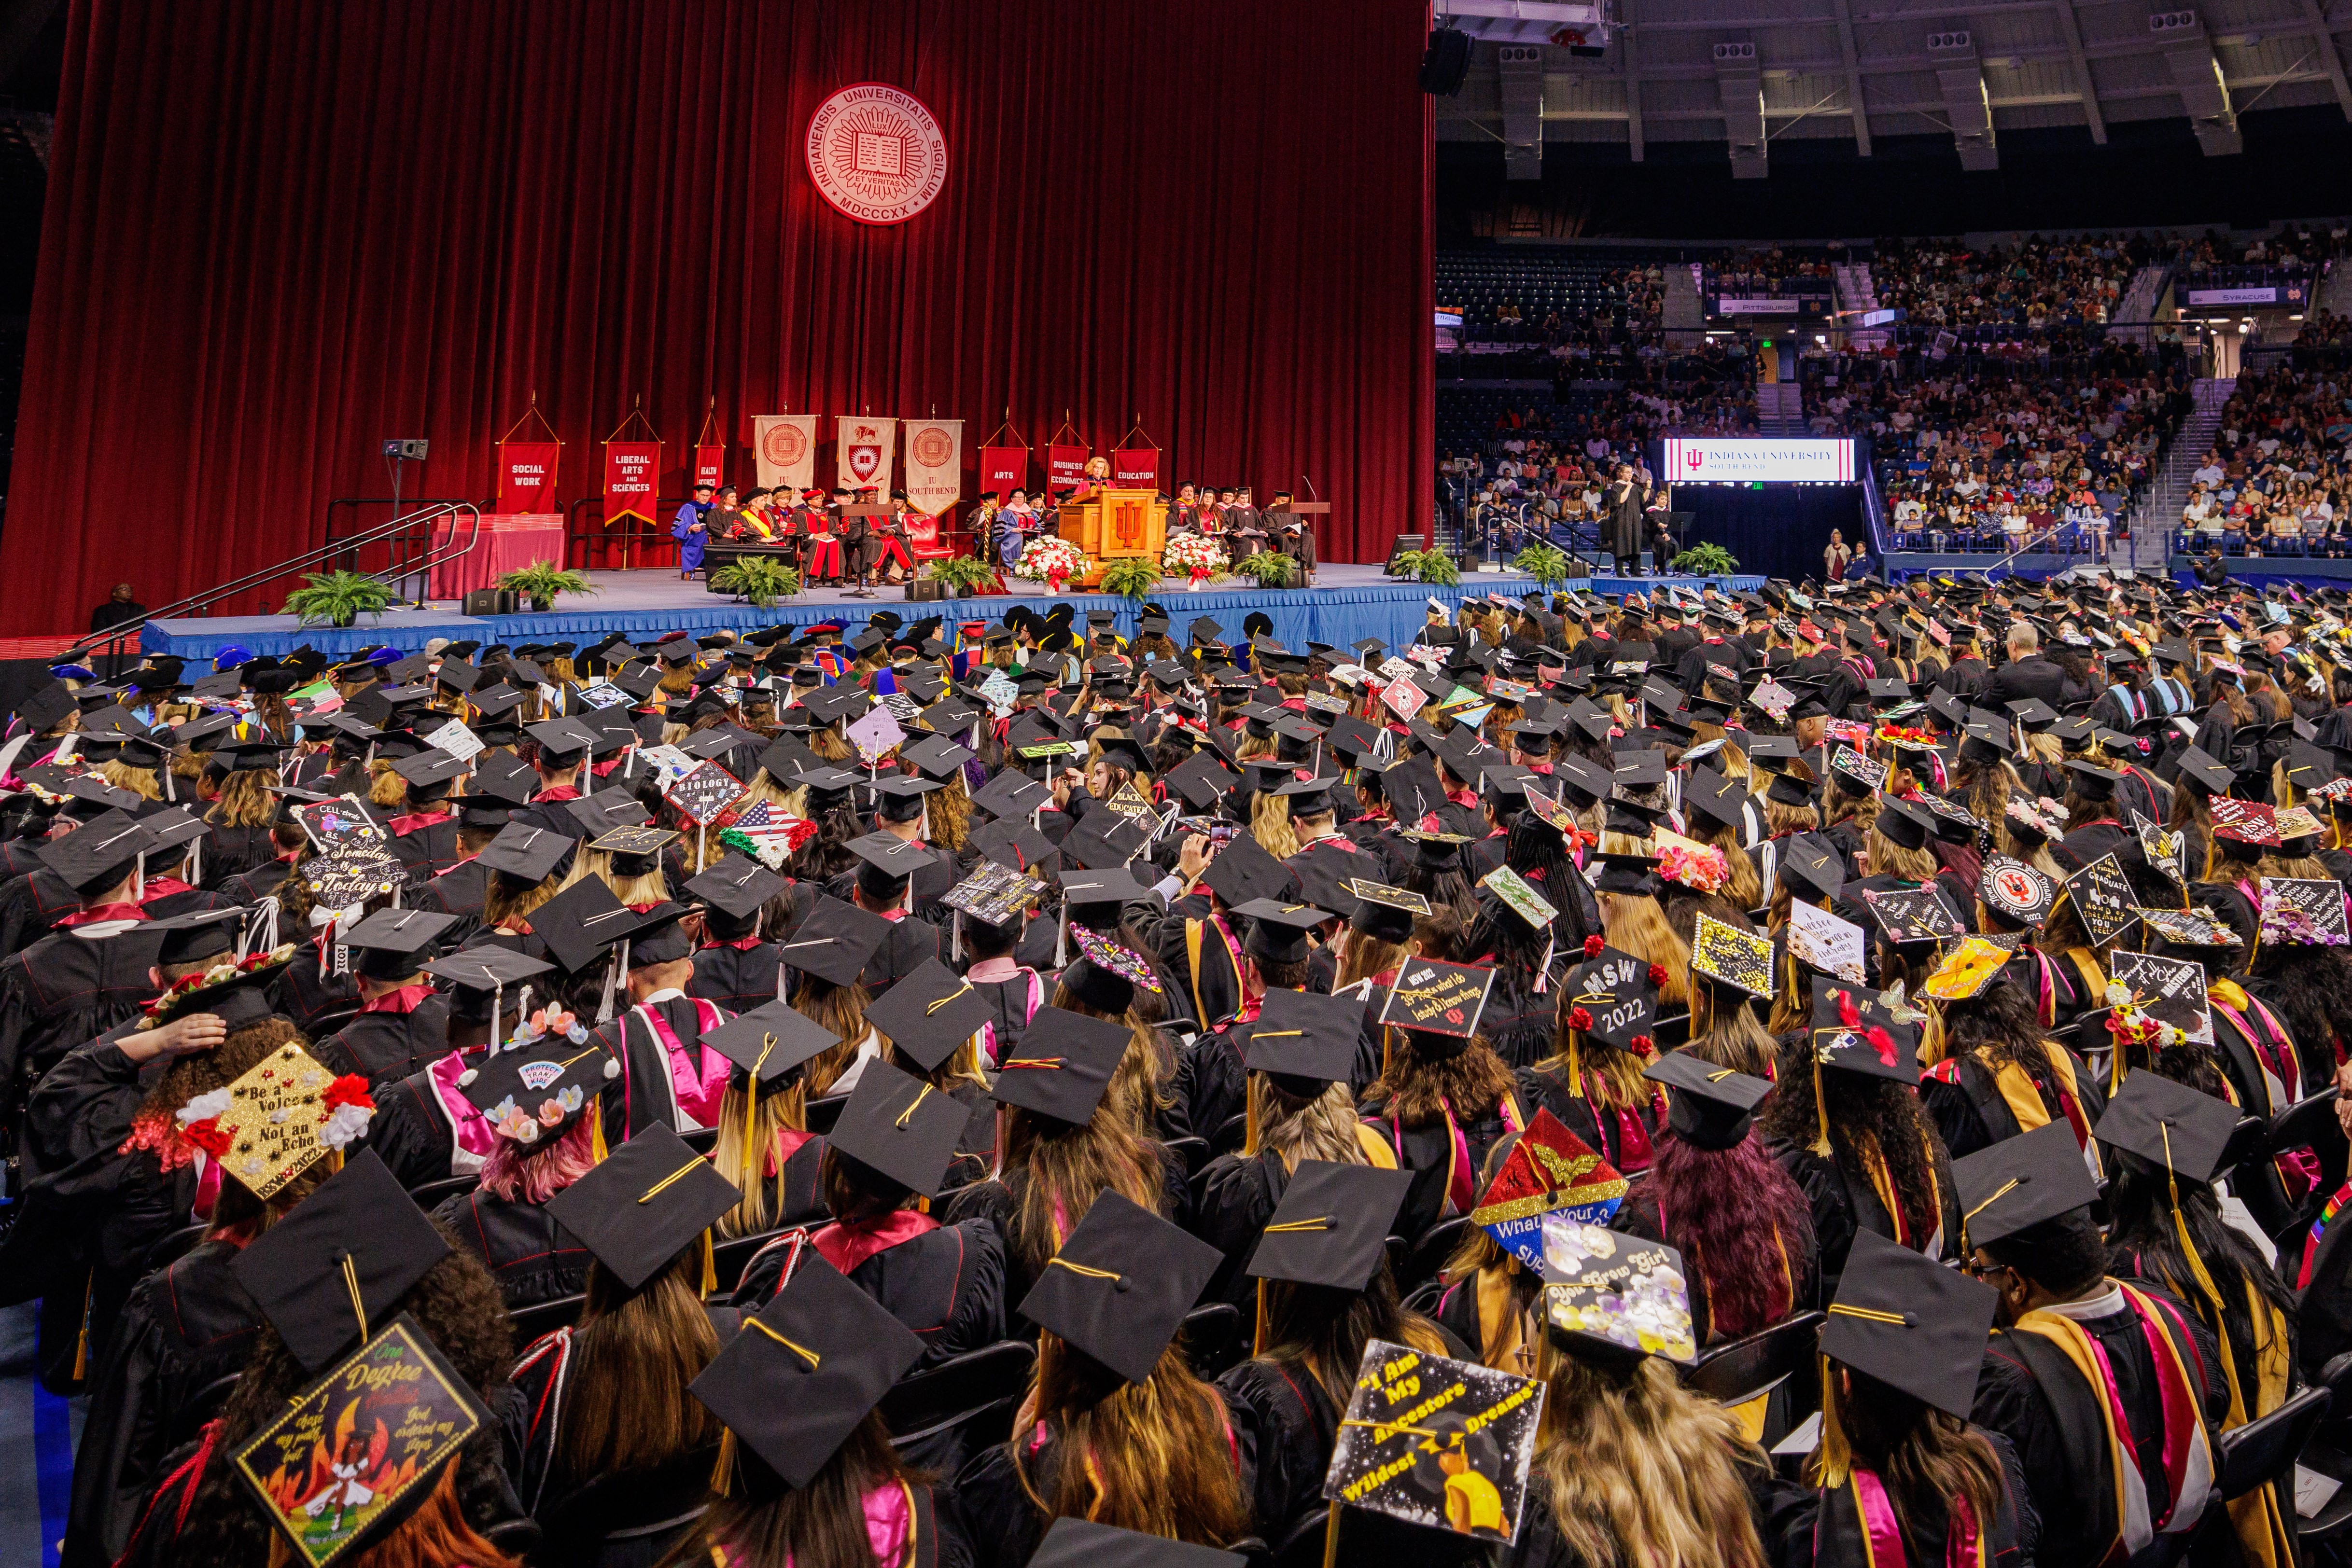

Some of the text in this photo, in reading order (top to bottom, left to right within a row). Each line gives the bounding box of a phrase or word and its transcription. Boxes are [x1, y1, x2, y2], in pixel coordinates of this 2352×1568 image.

[873, 123, 887, 131] LUX
[811, 88, 944, 201] INDIANENSIS UNIVERSITATIS SIGILLUM
[868, 177, 901, 188] VERITAS
[840, 197, 909, 220] MDCCCXX
[616, 455, 650, 464] LIBERAL
[1710, 451, 1759, 460] INDIANA
[512, 465, 545, 473] SOCIAL
[1053, 461, 1083, 470] BUSINESS
[515, 477, 541, 486] WORK
[612, 484, 650, 492] SCIENCES
[936, 486, 957, 495] BEND
[679, 778, 729, 792] BIOLOGY
[1118, 793, 1141, 802] BLACK
[2234, 815, 2268, 837] MSW
[2247, 825, 2279, 843] 2022
[319, 836, 342, 847] biolog
[331, 843, 391, 861] Someday
[322, 873, 377, 900] Today
[1984, 886, 2001, 905] Never
[2001, 856, 2024, 867] Follow
[2025, 863, 2042, 878] Your
[2039, 876, 2052, 903] Dreams
[2088, 871, 2128, 893] GRADUATE
[2273, 880, 2292, 895] Love
[1894, 900, 1912, 920] Change
[2024, 912, 2044, 922] 2022
[2092, 918, 2110, 928] YOU
[2093, 926, 2115, 936] FEEL?
[337, 947, 347, 970] 2022
[1731, 960, 1751, 971] DID
[1407, 968, 1436, 986] MSW 2022
[1436, 978, 1453, 992] what
[1454, 972, 1465, 984] do
[1583, 959, 1637, 994] MSW
[1738, 970, 1764, 983] THIS
[2160, 965, 2196, 998] MASTERED
[1416, 1004, 1436, 1019] study
[1461, 986, 1481, 1002] things
[1601, 999, 1646, 1033] 2022
[524, 1064, 561, 1074] PROTECT
[250, 1086, 281, 1100] Be a
[259, 1123, 309, 1143] Not an
[281, 1134, 314, 1152] Echo
[290, 1148, 322, 1174] 2022
[1549, 1281, 1586, 1304] You
[1628, 1247, 1669, 1275] Girl
[374, 1344, 404, 1363] One
[346, 1360, 422, 1393] Degree
[1384, 1353, 1419, 1384] Am
[1385, 1375, 1420, 1405] My
[405, 1407, 431, 1425] God
[1373, 1382, 1466, 1445] Ancestors
[394, 1419, 455, 1439] ordered my
[282, 1447, 304, 1464] but
[1342, 1452, 1417, 1501] Wildest
